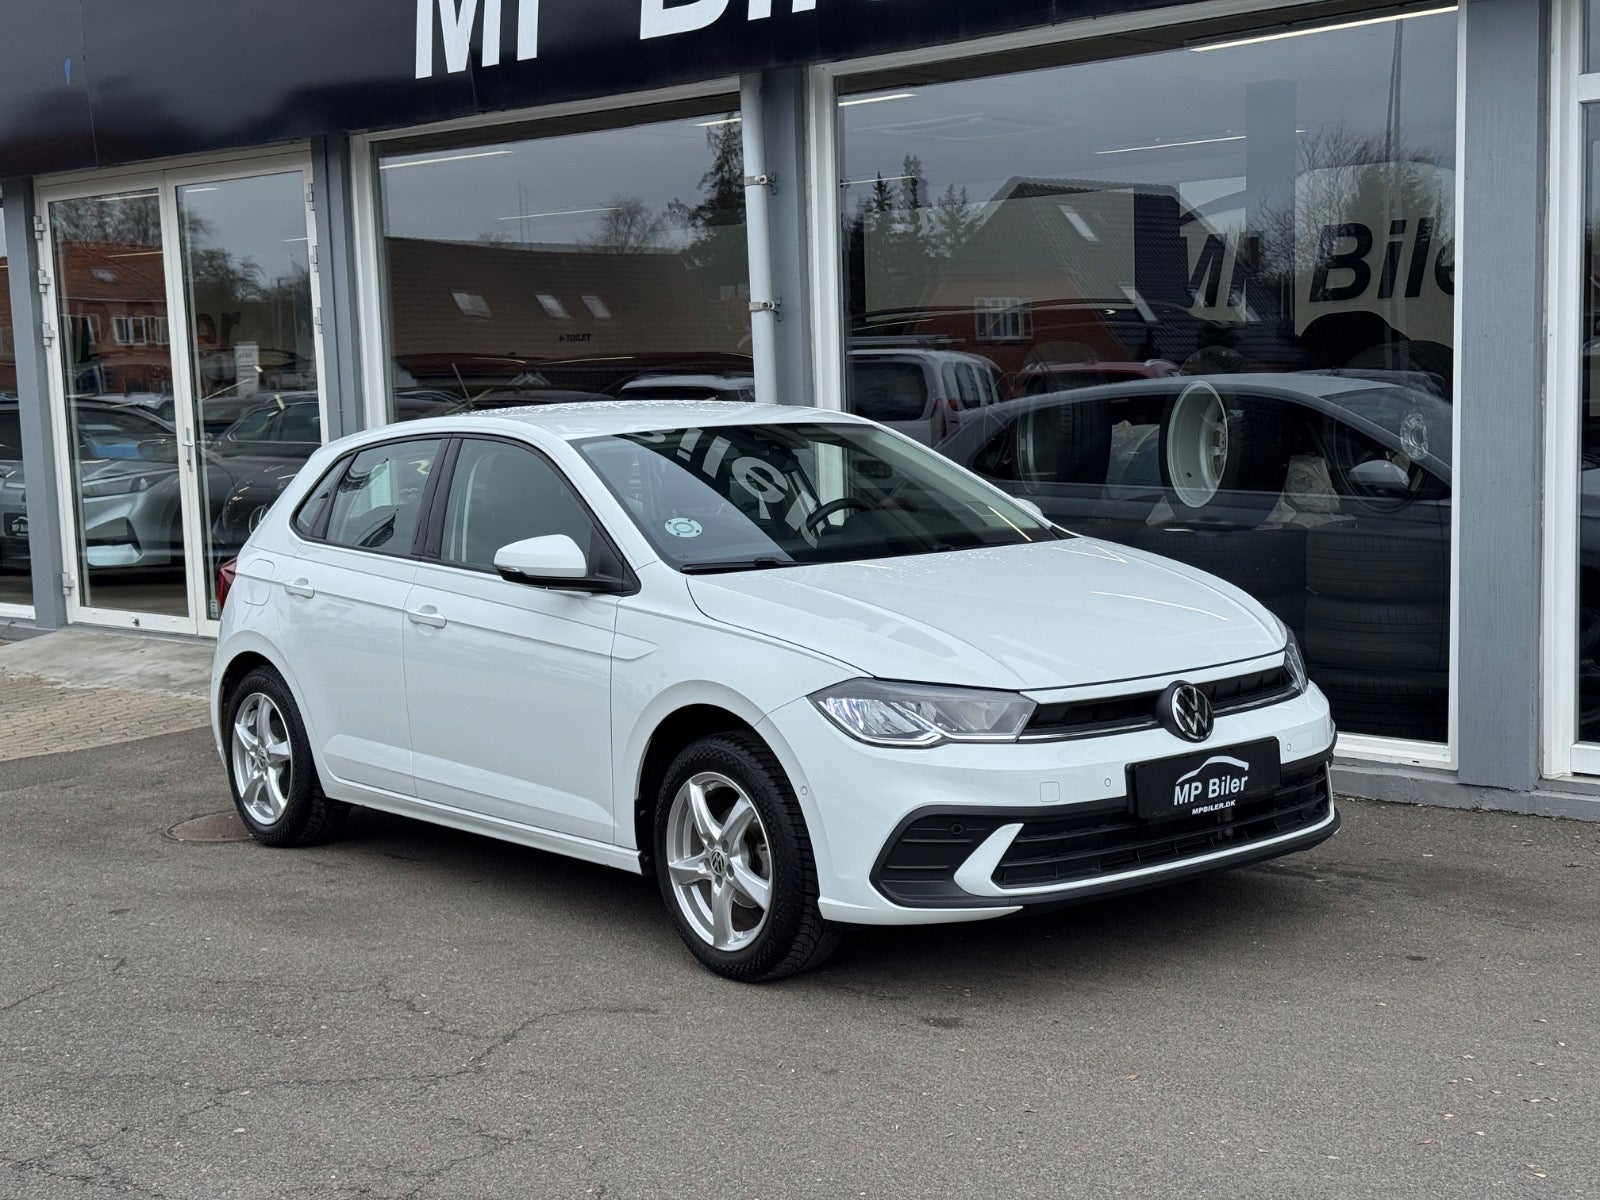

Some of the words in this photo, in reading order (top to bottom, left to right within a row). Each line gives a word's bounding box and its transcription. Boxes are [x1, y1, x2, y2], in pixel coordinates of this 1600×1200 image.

[1174, 782, 1202, 806] MP
[1208, 775, 1248, 798] Biler
[1192, 800, 1236, 815] MPBILER.DK
